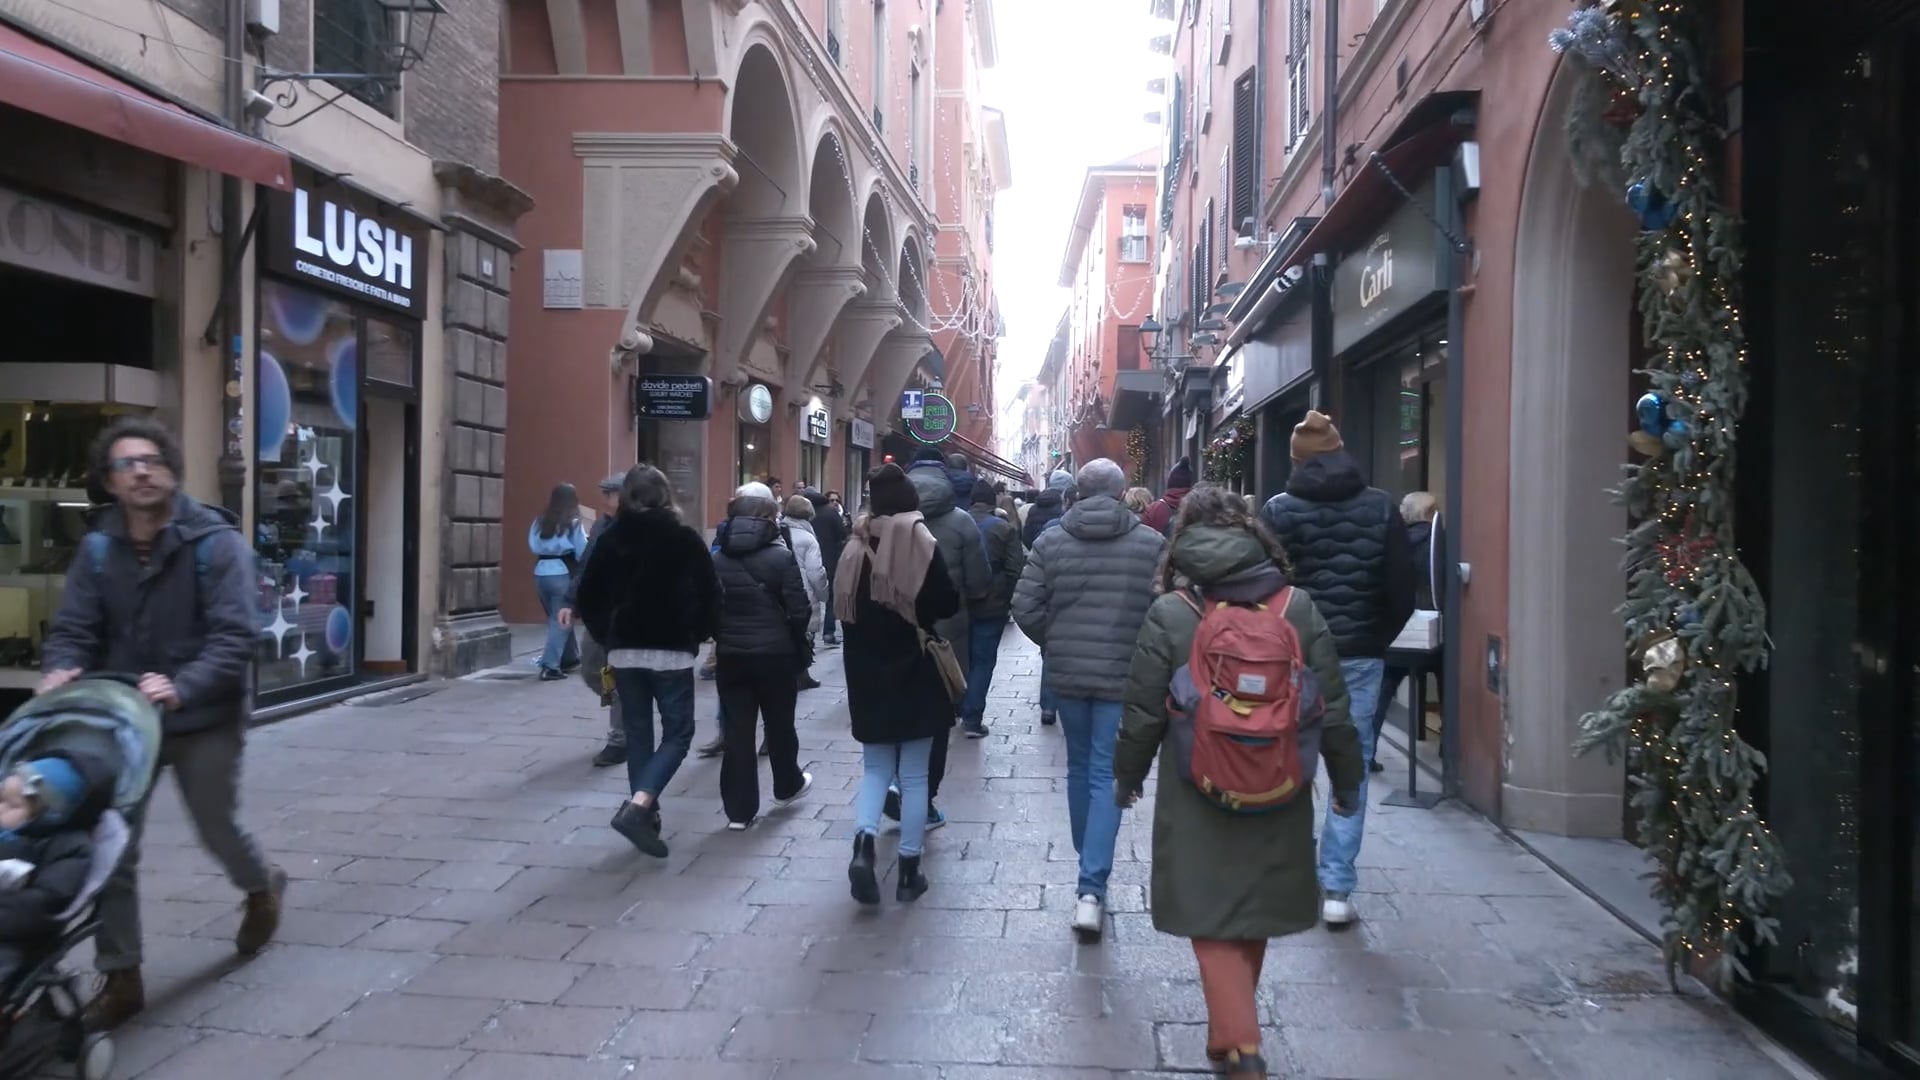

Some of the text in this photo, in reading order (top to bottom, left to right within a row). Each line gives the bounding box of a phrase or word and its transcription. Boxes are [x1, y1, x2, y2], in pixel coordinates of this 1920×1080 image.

[0, 200, 141, 282] ONDI
[295, 188, 411, 289] LUSH
[1360, 248, 1393, 308] Carli
[641, 380, 702, 392] davide pedretti
[924, 417, 946, 430] bar
